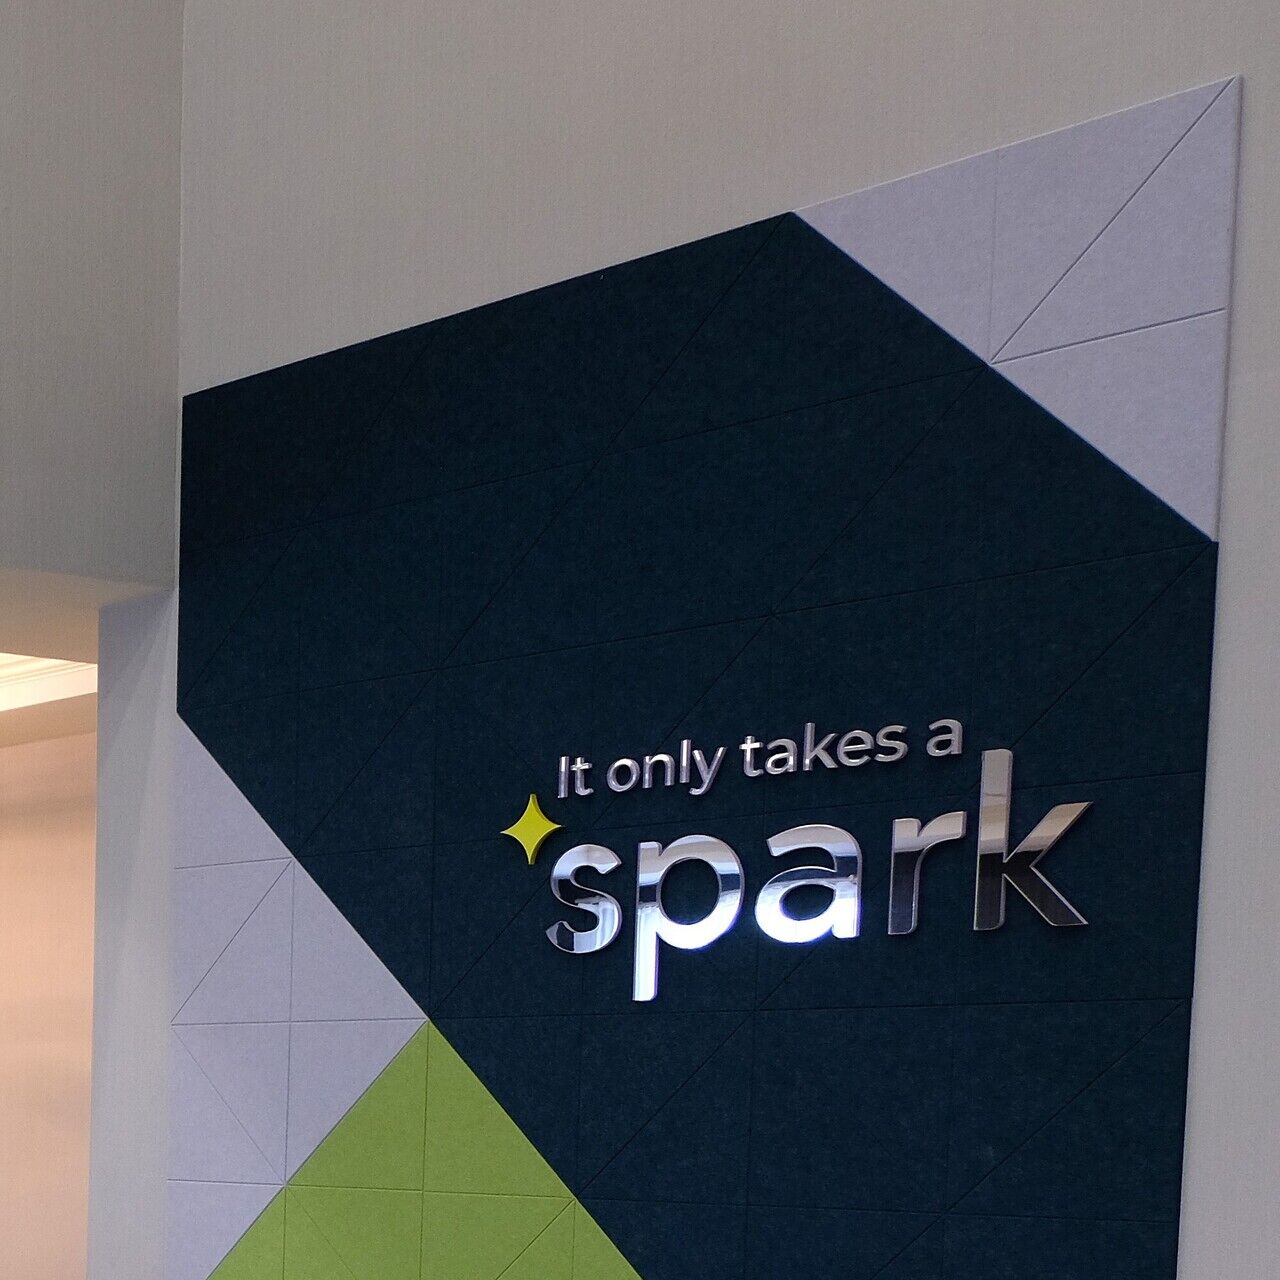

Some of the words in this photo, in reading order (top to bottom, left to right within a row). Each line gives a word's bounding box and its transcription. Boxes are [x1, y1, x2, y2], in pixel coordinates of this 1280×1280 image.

[557, 755, 594, 798] It
[606, 739, 727, 795] only
[740, 721, 908, 777] takes
[926, 718, 963, 757] a
[545, 749, 1093, 1001] spark
